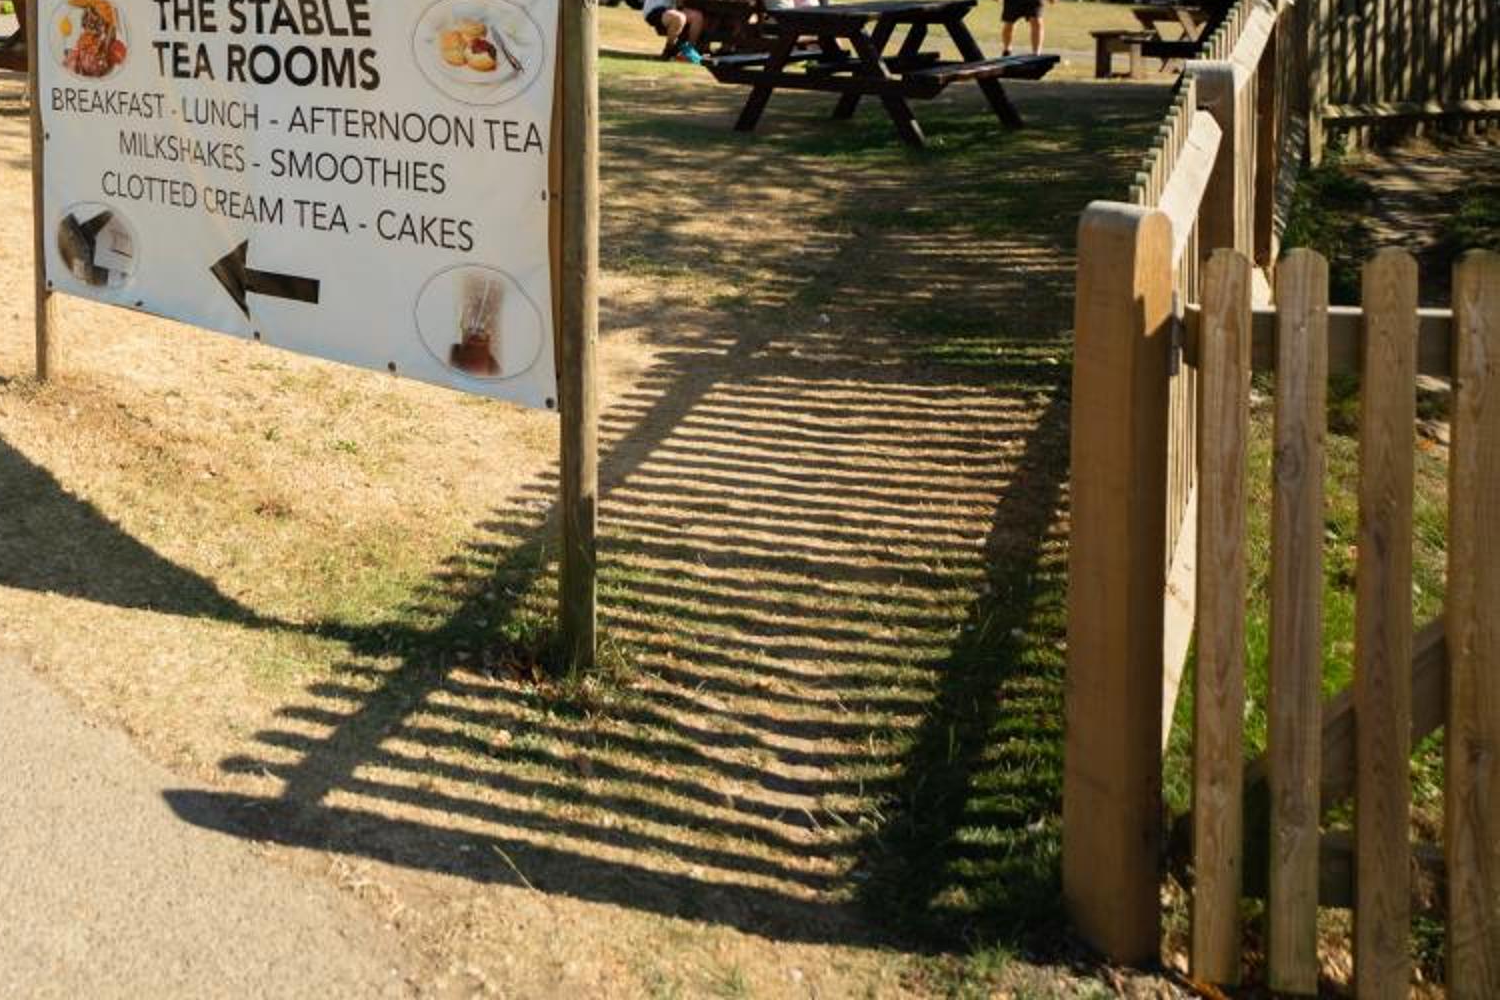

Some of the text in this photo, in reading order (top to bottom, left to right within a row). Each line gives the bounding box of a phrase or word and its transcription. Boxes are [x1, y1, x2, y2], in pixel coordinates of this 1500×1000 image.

[152, 41, 380, 91] TEA ROOMS
[51, 87, 165, 119] BREAKFAST
[182, 96, 259, 131] LUNCH
[288, 105, 475, 148] AFTERNOON
[483, 119, 544, 154] TEA
[119, 130, 245, 172] MILKSHAKES
[270, 149, 446, 194] SMOOTHIES
[101, 171, 197, 209] CLOTTED
[204, 186, 283, 225] CREAM
[294, 200, 349, 233] TEA
[377, 209, 473, 252] CAKES
